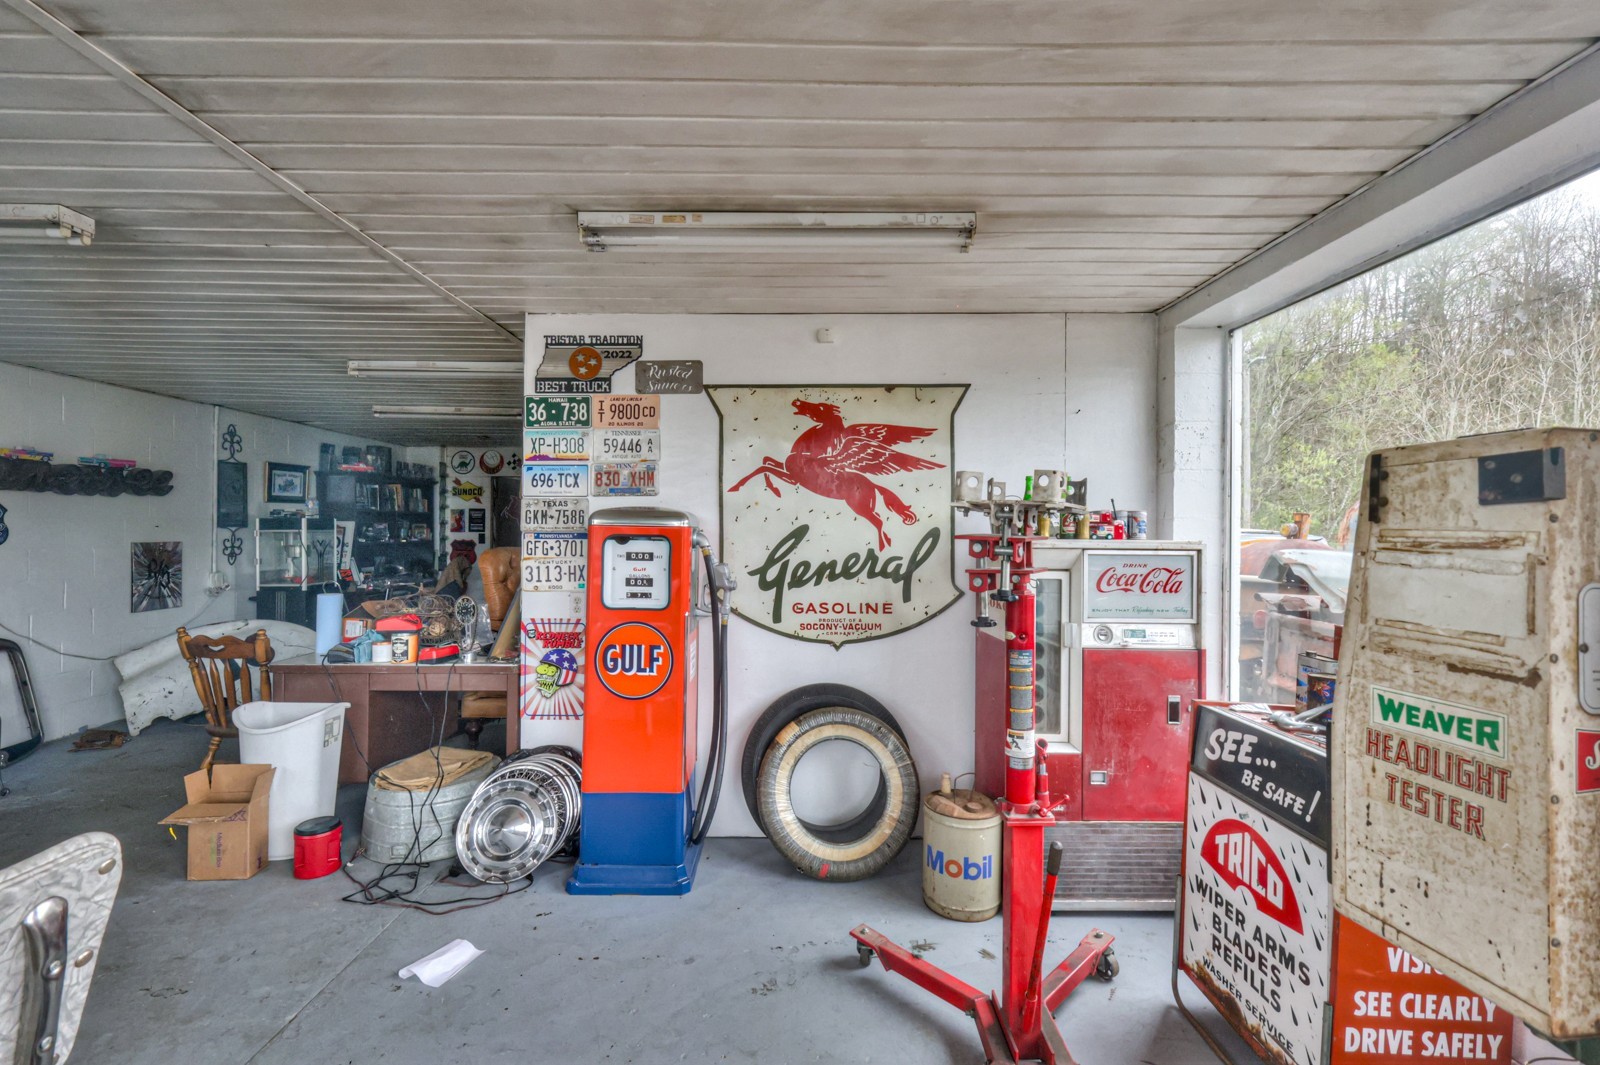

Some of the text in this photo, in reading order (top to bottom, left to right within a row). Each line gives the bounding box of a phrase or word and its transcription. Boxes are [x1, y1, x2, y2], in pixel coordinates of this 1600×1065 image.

[544, 335, 643, 344] TRISTAR TRADITION
[603, 350, 632, 358] 2022
[536, 381, 610, 392] BEST TRUCK
[610, 404, 656, 420] 9800 CD
[530, 438, 584, 454] XP-H308
[604, 438, 642, 453] 59446
[452, 486, 482, 496] SUNOCO
[596, 472, 654, 486] 830 XHM
[747, 524, 940, 624] General
[1096, 566, 1186, 594] Coca-Cola
[792, 602, 893, 614] GASOLINE
[536, 632, 582, 640] REDNECK
[542, 639, 582, 648] RUMBLE
[602, 644, 664, 676] GULF
[1376, 692, 1500, 752] WEAVER
[1366, 727, 1512, 803] HEADLIGHT
[1241, 770, 1263, 792] BE
[1385, 772, 1486, 841] TESTER
[926, 844, 992, 880] Mobil
[1214, 832, 1284, 910] TRICO
[1195, 874, 1311, 986] WIPER ARMS
[1212, 912, 1282, 988] BLADES
[1212, 934, 1282, 1013] REFILLS
[1202, 955, 1295, 1055] WASHER SERVICE
[1353, 990, 1497, 1022] SEE CLEARLY
[1344, 1027, 1504, 1060] DRIVE SAFELY
